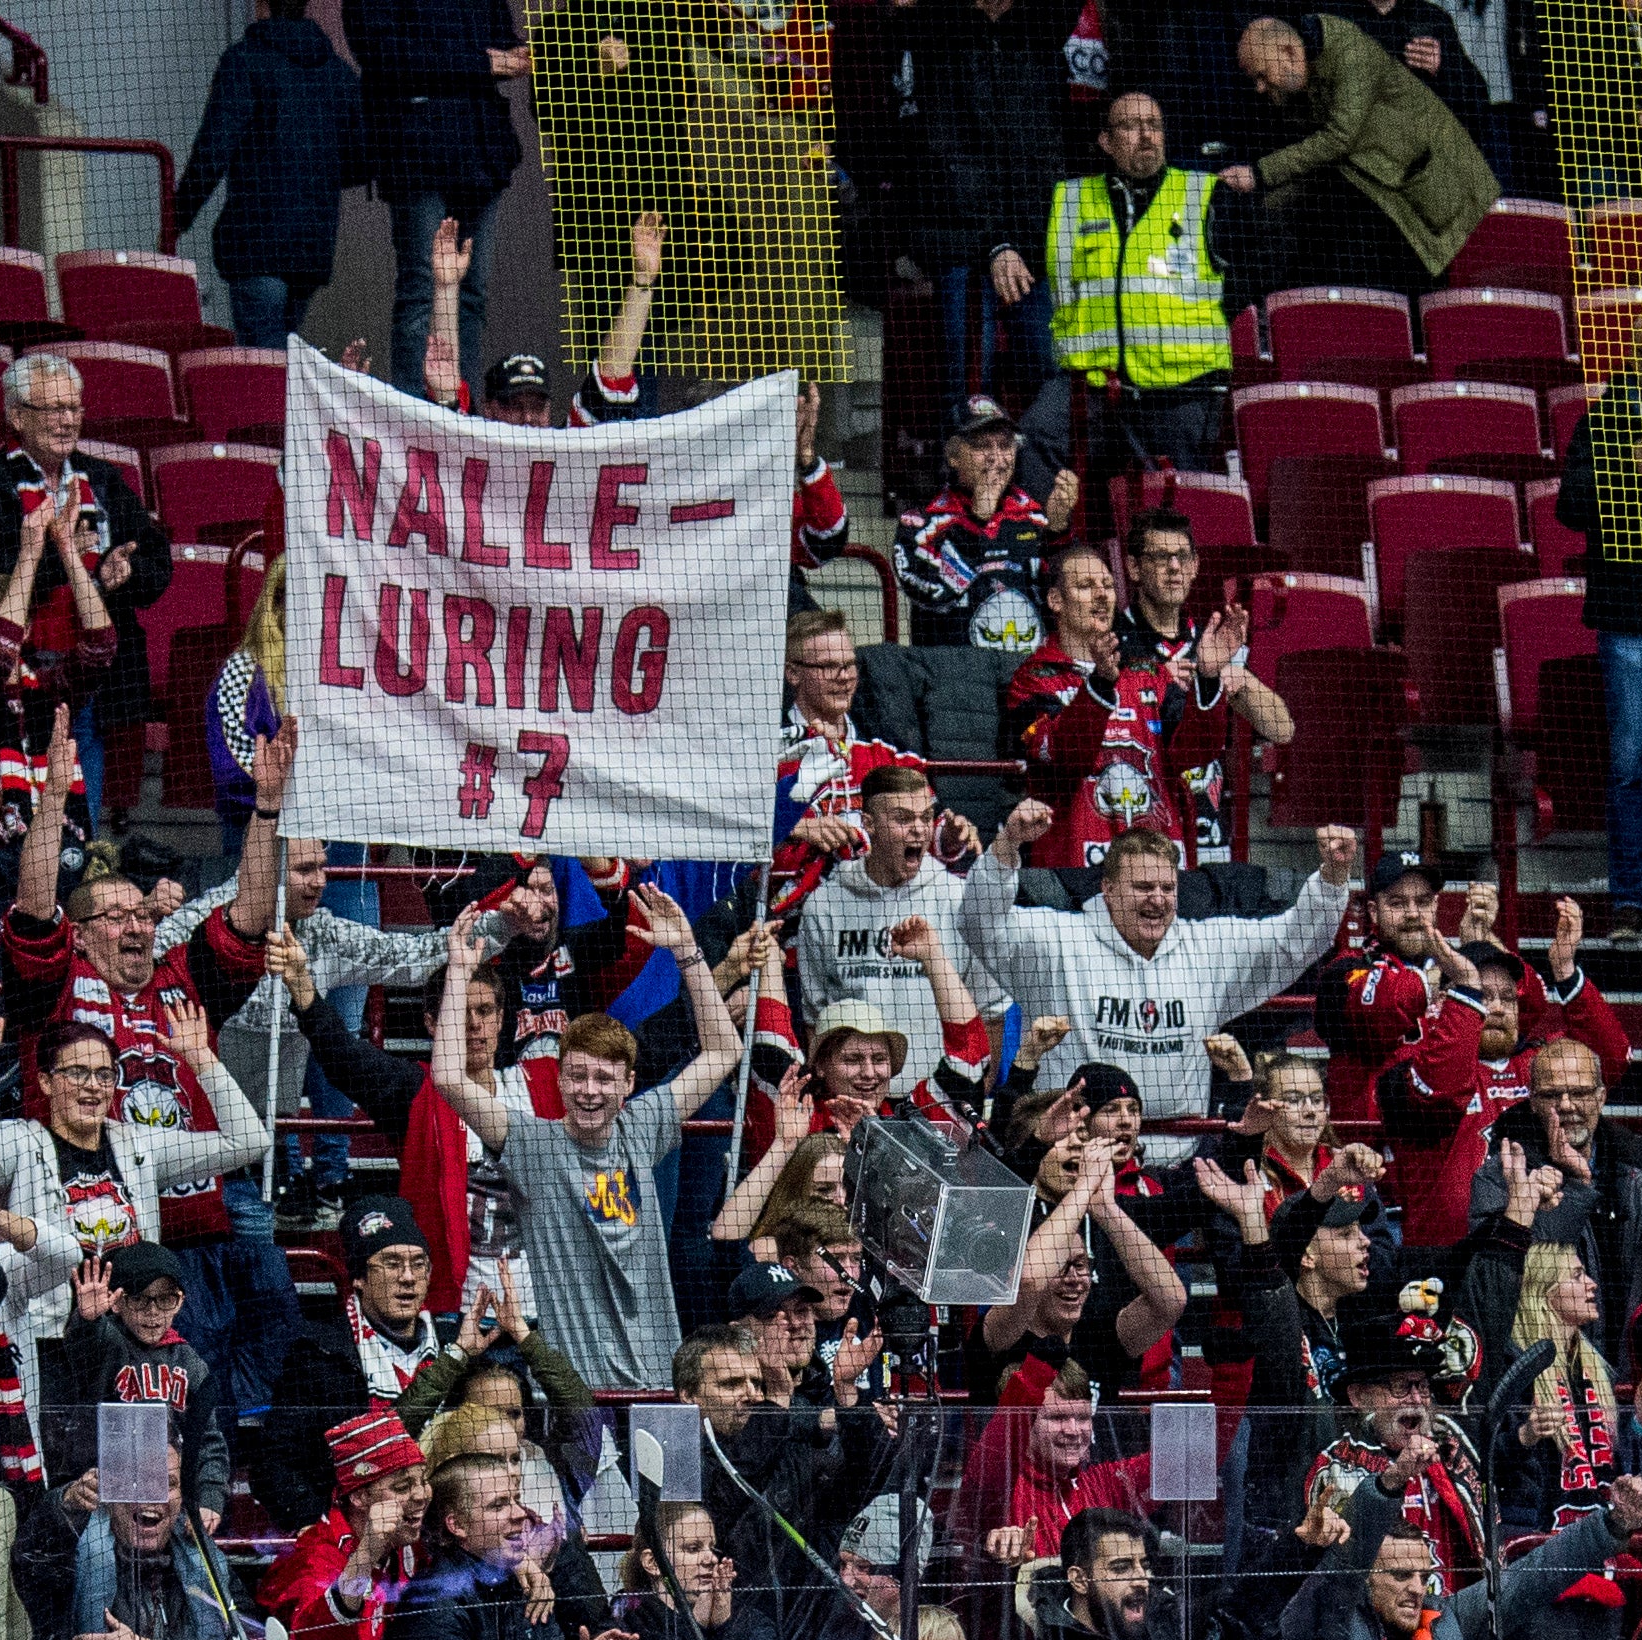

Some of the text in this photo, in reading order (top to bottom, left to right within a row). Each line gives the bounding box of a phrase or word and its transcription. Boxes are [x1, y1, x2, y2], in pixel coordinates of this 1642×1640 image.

[319, 575, 670, 714] LURING
[457, 730, 572, 839] #7
[1097, 999, 1185, 1028] FM 10
